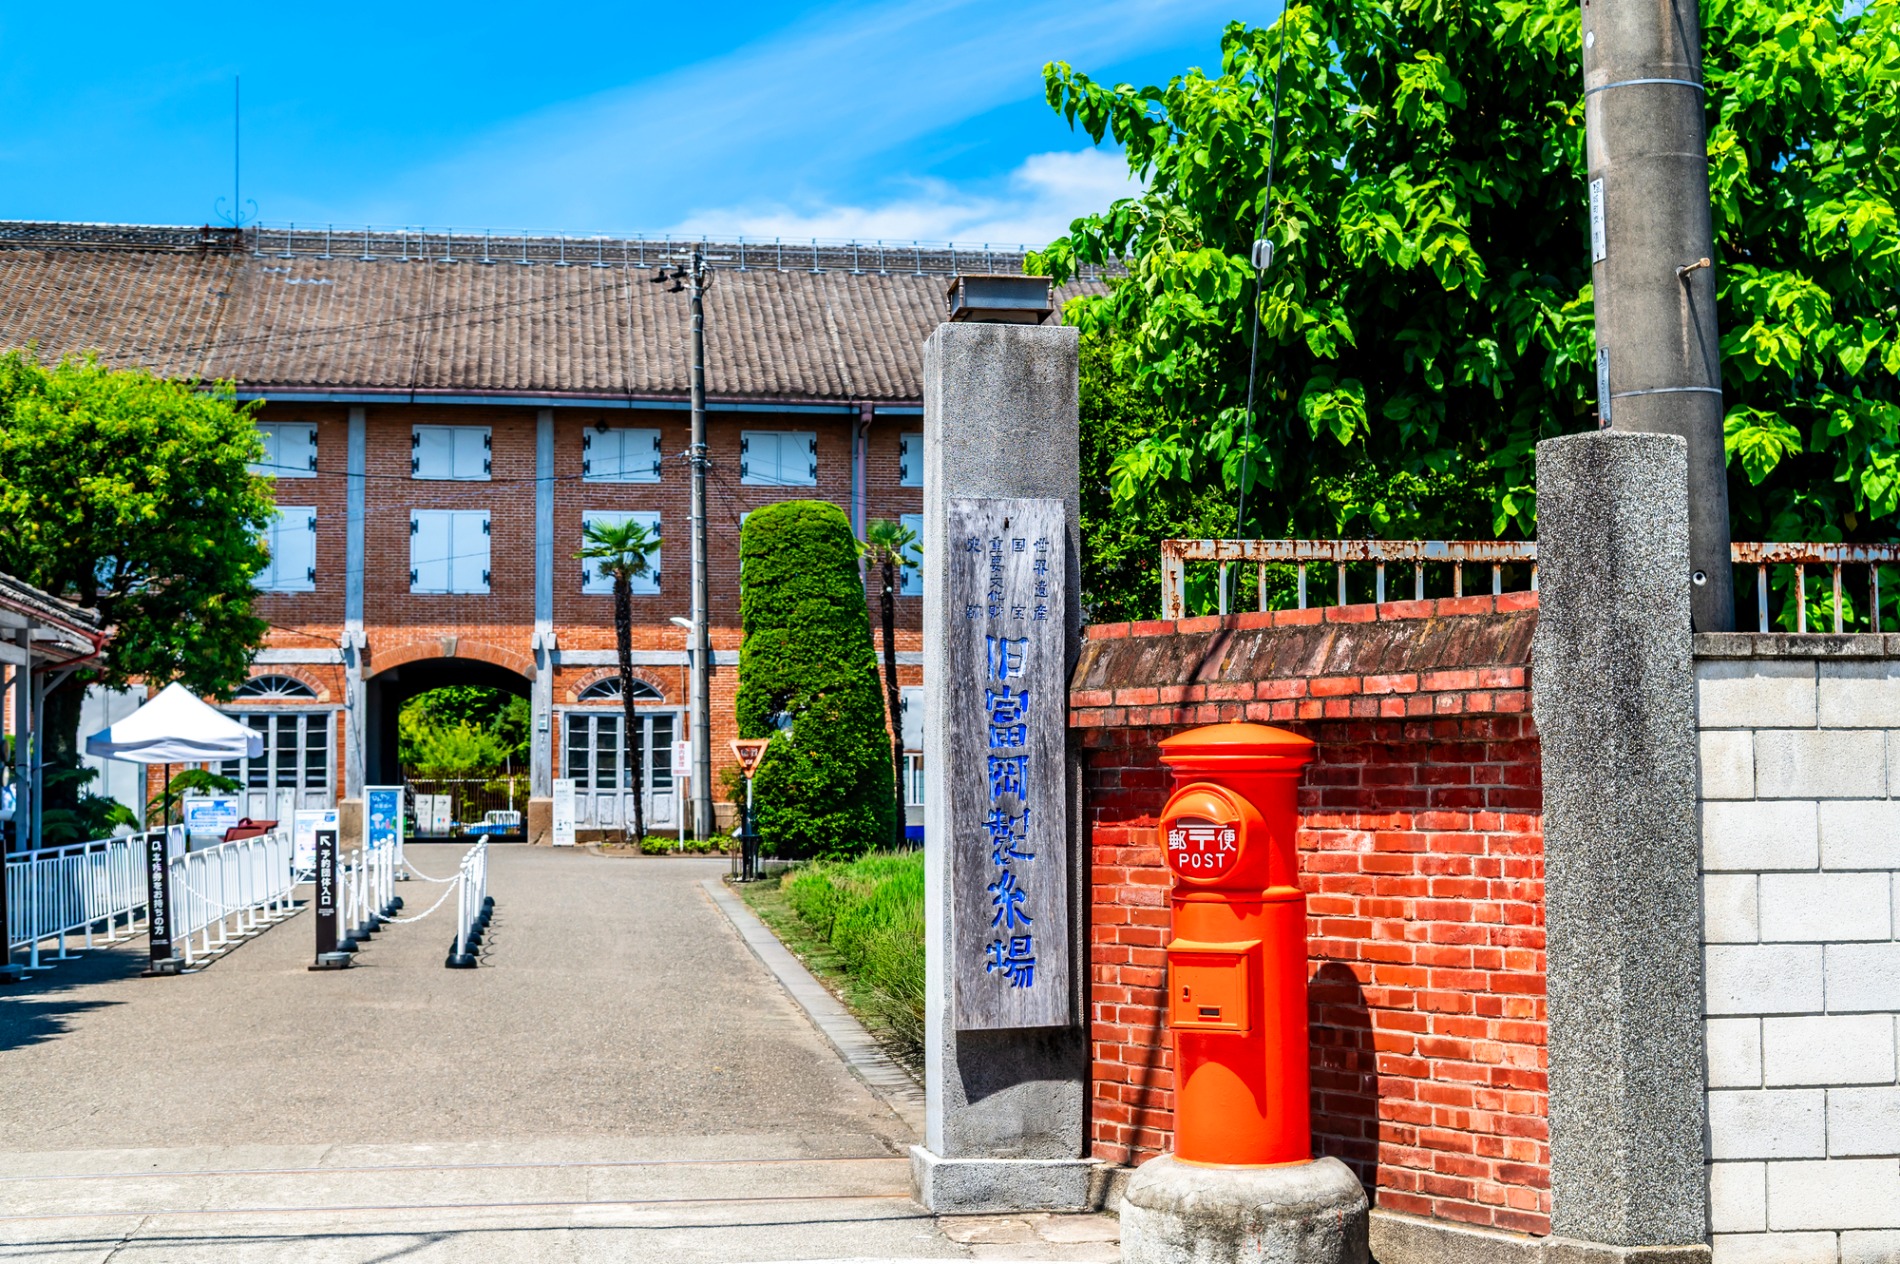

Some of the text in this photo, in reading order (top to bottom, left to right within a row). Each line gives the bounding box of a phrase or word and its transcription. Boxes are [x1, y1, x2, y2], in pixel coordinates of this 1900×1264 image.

[966, 536, 983, 619] 史跡
[988, 536, 1005, 619] 重要文化財
[1011, 537, 1026, 620] 国宝
[1033, 537, 1049, 621] 世界遺産
[981, 633, 1037, 989] 旧富岡製糸場
[320, 849, 332, 906] 予約団体入口
[1178, 853, 1226, 869] POST
